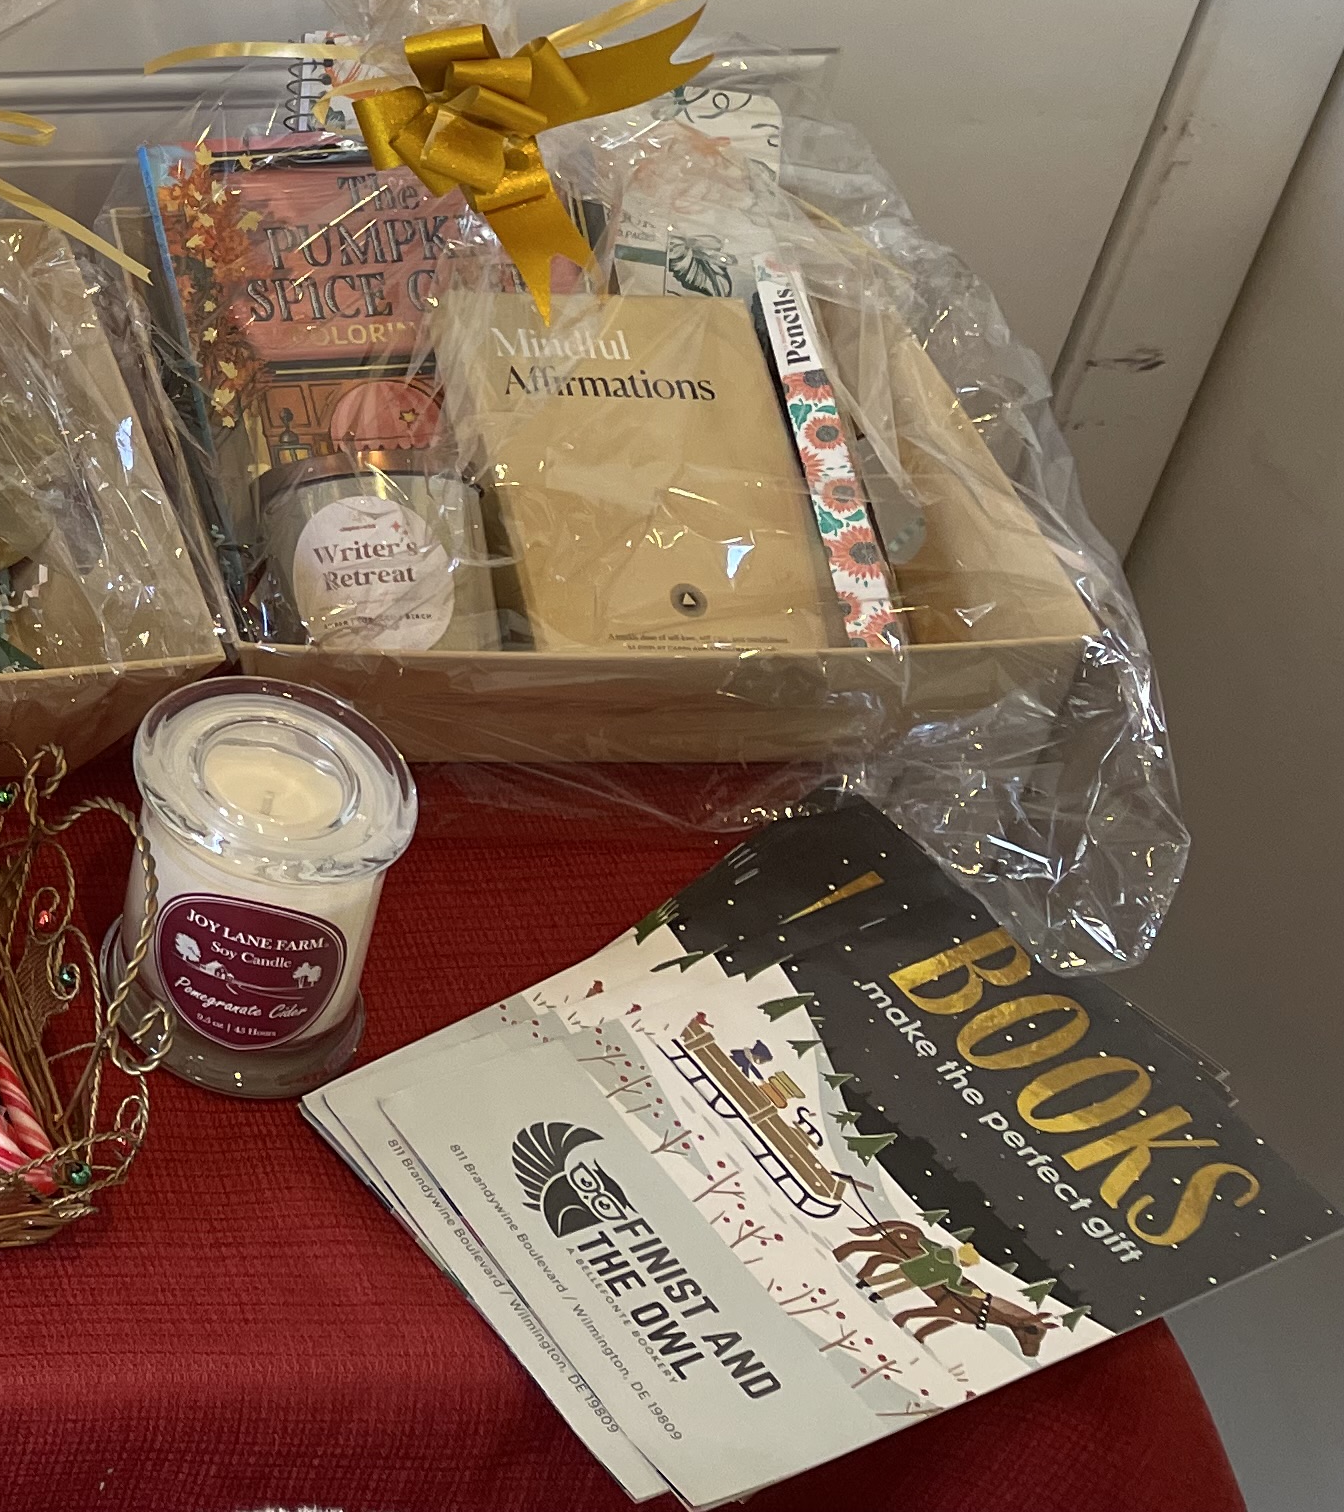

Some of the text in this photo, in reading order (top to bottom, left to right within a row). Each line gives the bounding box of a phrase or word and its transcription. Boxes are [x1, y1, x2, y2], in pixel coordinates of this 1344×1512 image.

[337, 173, 419, 214] The
[246, 271, 393, 323] SPICE
[490, 327, 631, 361] Mindful
[773, 286, 811, 366] Pencils
[505, 365, 716, 401] Affirmations
[313, 537, 419, 565] Writer's
[323, 564, 417, 592] Retreat
[186, 908, 326, 952] JOY LANE FARM
[210, 940, 292, 969] Soy Candle
[174, 976, 308, 1020] Pomegranate Cider
[888, 926, 1260, 1247] BOOKS
[858, 980, 1143, 1264] make the perfect gift
[388, 1138, 619, 1433] 811 Brandywine Boulevard Wilmington, DE 19809
[449, 1143, 683, 1441] 811 Brandywine Boulevard Wilmington, DE 19809
[577, 1230, 705, 1381] THE OWL
[612, 1217, 782, 1400] FINIST AND
[566, 1247, 679, 1383] A BELLEFONTE BOOKERY
